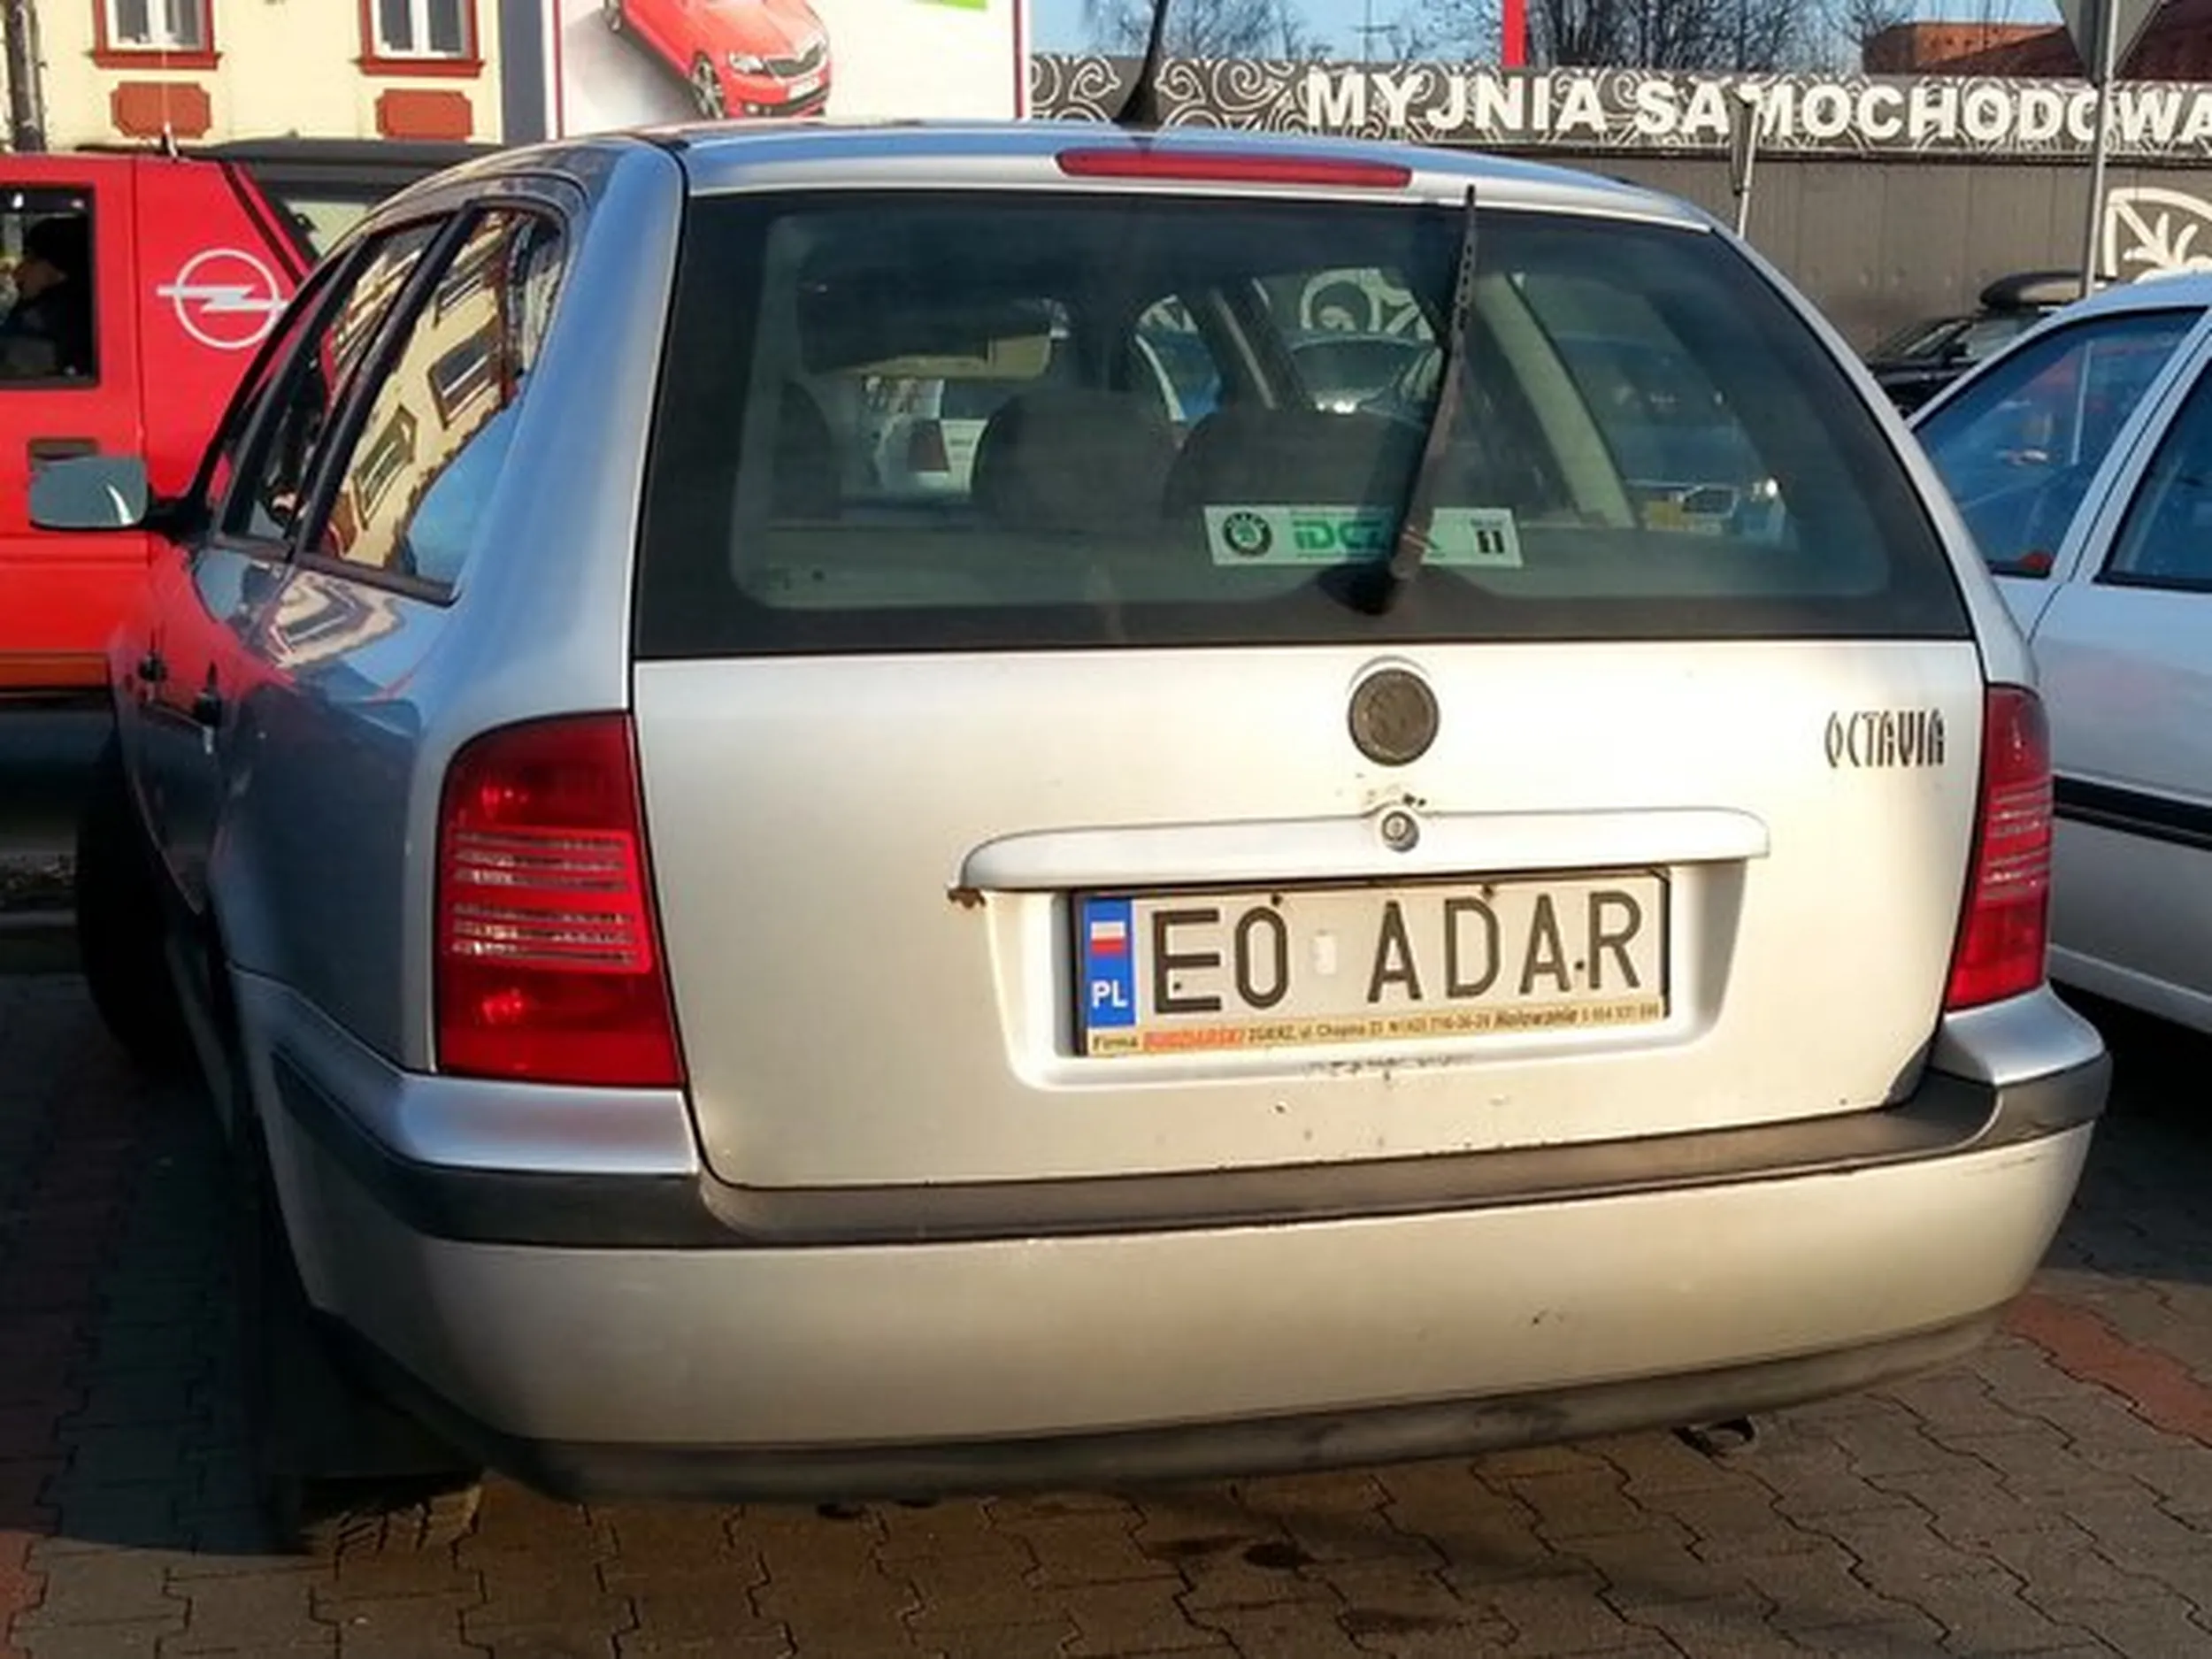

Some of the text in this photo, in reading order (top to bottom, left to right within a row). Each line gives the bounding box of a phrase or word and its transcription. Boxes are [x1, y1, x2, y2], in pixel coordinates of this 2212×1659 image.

[1307, 73, 2212, 142] MYJNIA SAMOCHODOWA
[1824, 708, 1944, 767] OCTAVIA
[1367, 890, 1642, 1002] ADAR
[1091, 980, 1128, 1009] PL
